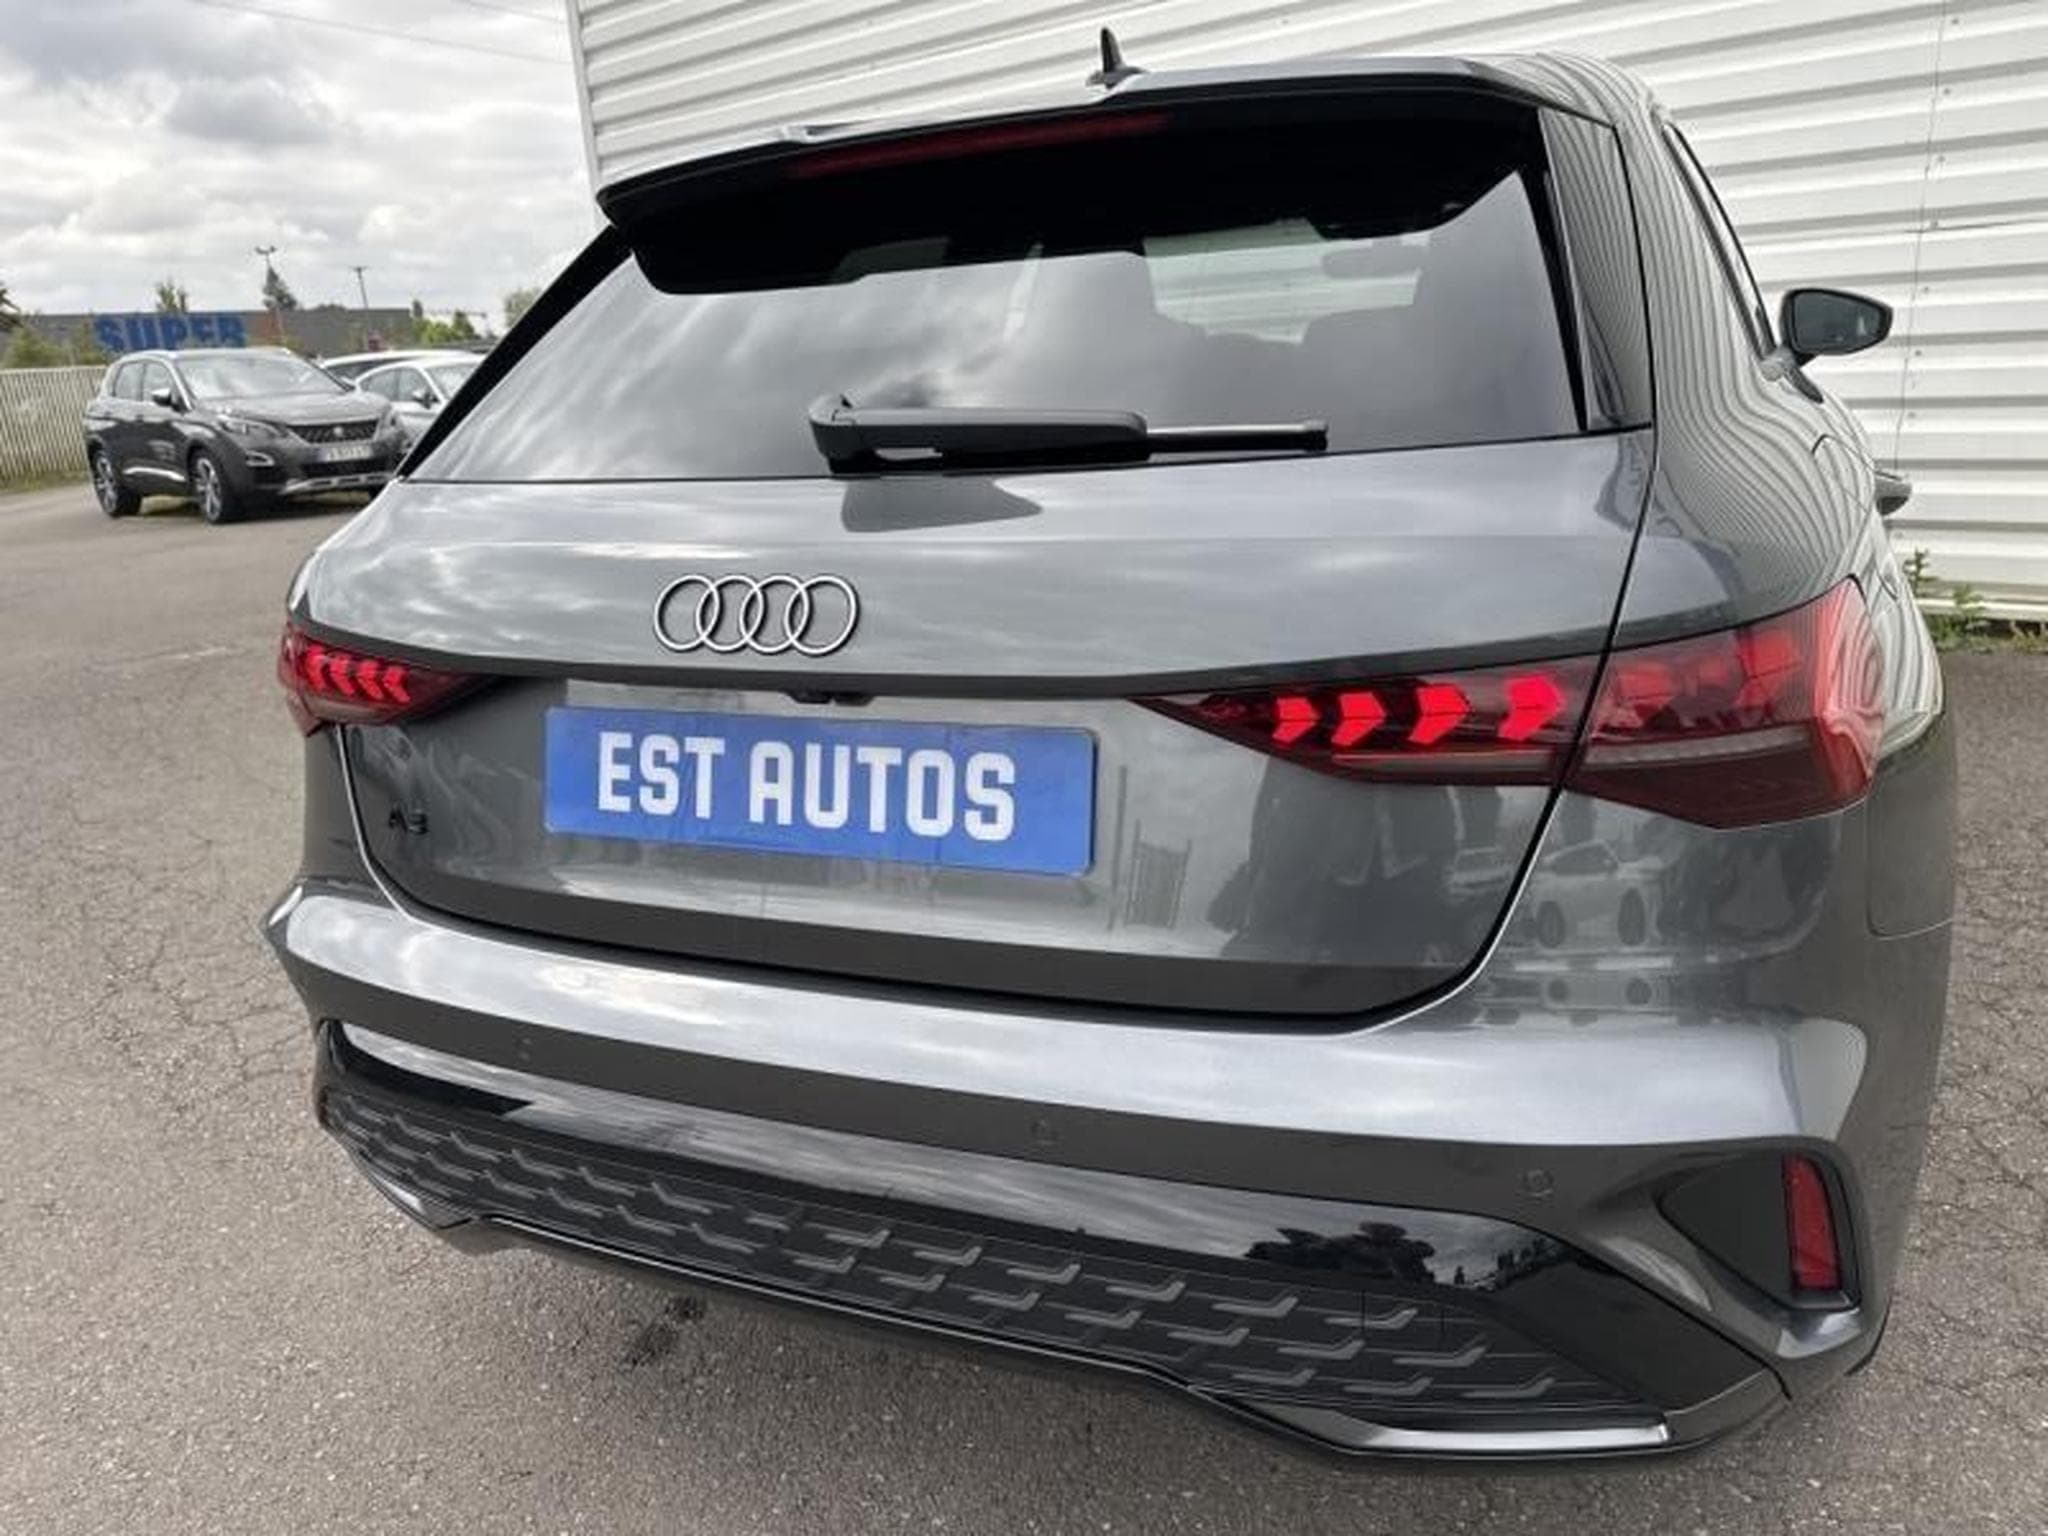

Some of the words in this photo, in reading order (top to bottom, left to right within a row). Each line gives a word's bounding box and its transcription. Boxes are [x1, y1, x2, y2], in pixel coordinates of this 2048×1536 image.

[95, 316, 247, 350] SUPER
[598, 731, 725, 820] EST
[749, 741, 1016, 841] AUTOS
